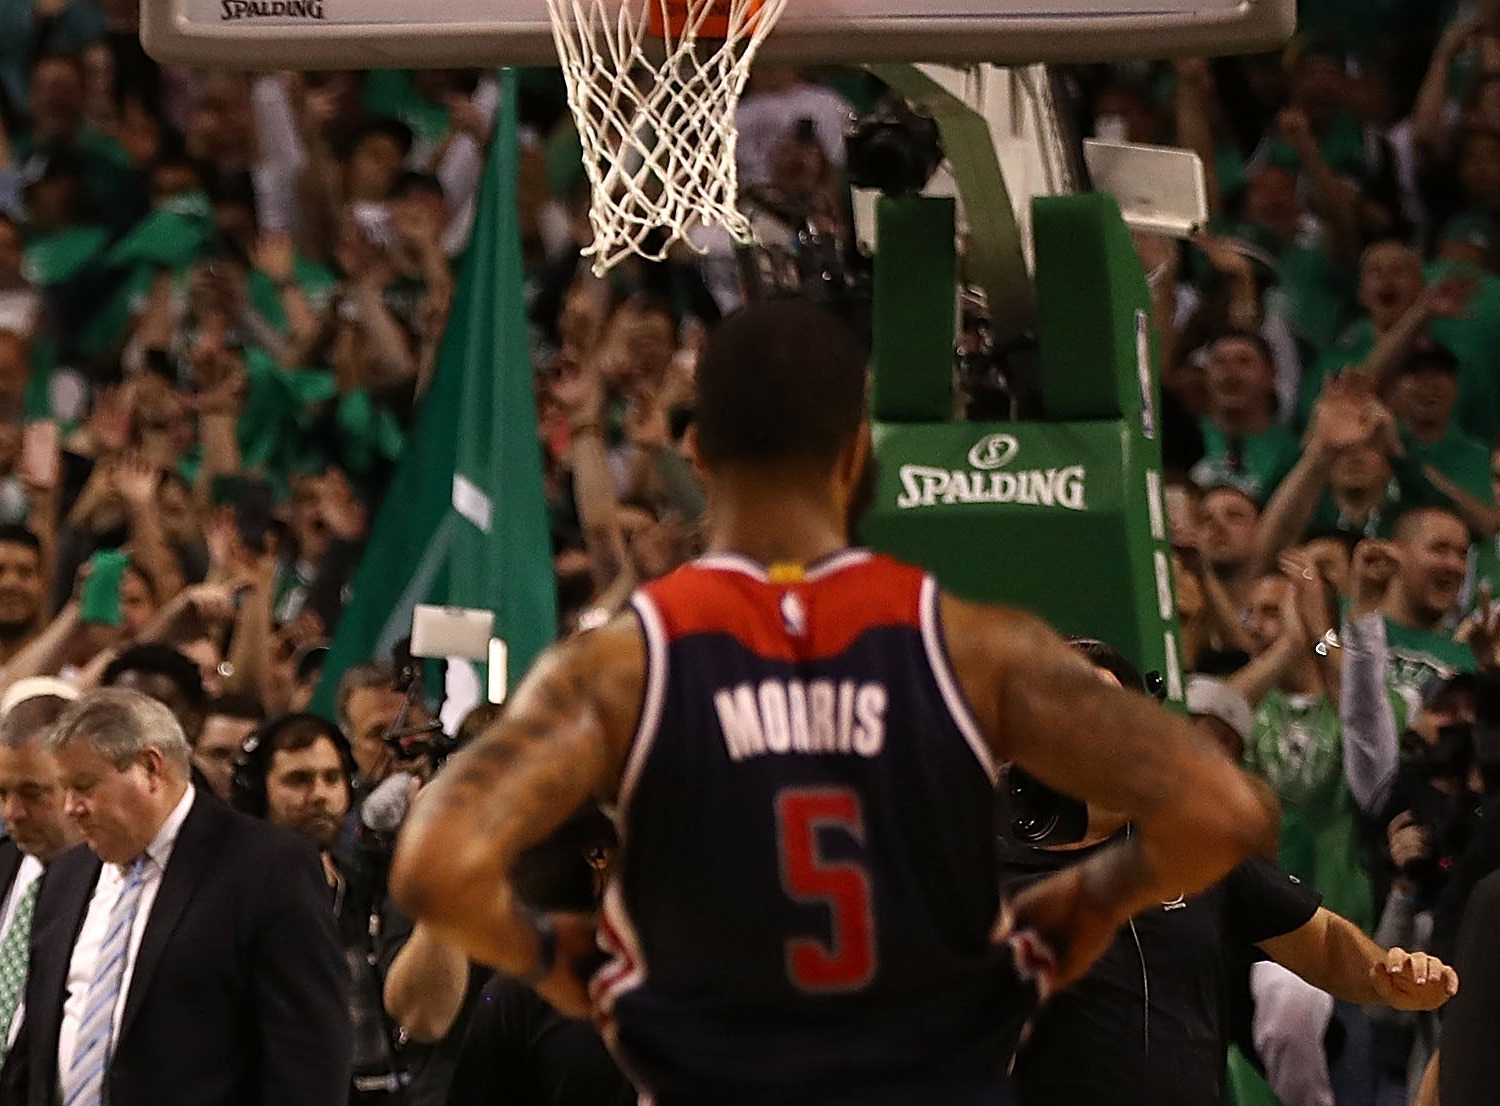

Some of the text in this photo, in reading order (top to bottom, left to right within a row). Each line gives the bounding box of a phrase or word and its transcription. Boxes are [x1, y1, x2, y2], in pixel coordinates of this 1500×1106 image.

[220, 0, 324, 20] SPALDING
[897, 463, 1087, 511] SPALDING
[713, 680, 888, 762] MORRIS
[773, 787, 877, 993] 5
